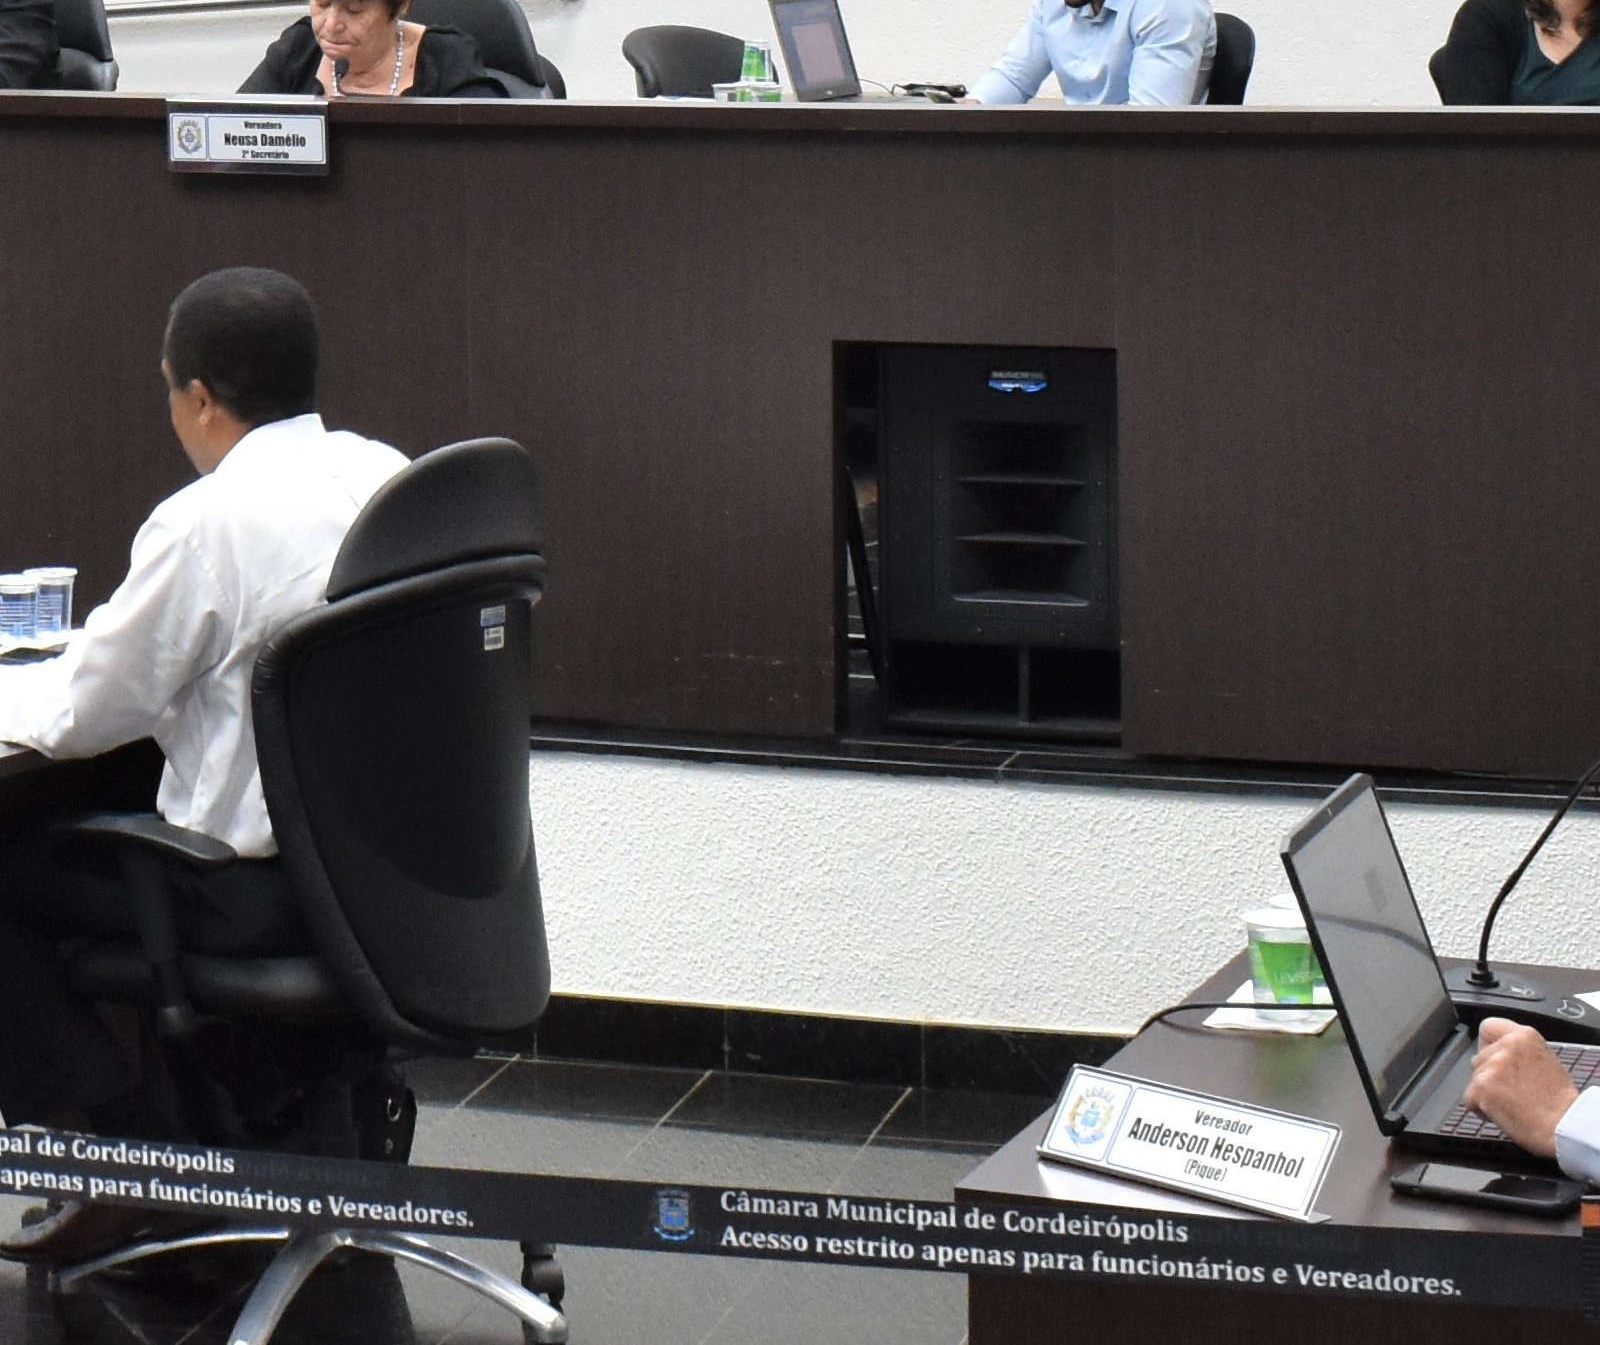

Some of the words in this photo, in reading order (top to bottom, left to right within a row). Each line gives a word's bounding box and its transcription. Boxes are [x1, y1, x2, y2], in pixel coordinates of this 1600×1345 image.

[224, 133, 258, 147] Neusa
[261, 133, 307, 147] Damélio
[244, 121, 282, 129] Vereadora
[1194, 1110, 1253, 1136] Vereador
[37, 1133, 66, 1157] de
[71, 1138, 235, 1175] Cordeirópolis
[1127, 1117, 1210, 1156] Anderson
[1210, 1136, 1305, 1179] Hespanhol
[1184, 1158, 1227, 1183] (Pique)
[0, 1167, 84, 1192] apenas
[90, 1176, 144, 1199] para
[150, 1179, 302, 1215] funcionários
[308, 1196, 322, 1215] e
[327, 1194, 475, 1228] Vereadores.
[720, 1190, 819, 1219] Câmara
[826, 1197, 957, 1232] Municipal
[964, 1207, 996, 1231] de
[1003, 1209, 1189, 1245] Cordeirópolis
[721, 1225, 808, 1252] Acesso
[815, 1234, 915, 1262] restrito
[921, 1243, 1016, 1268] apenas
[1023, 1250, 1085, 1273] para
[1091, 1249, 1266, 1285] funcionários
[1273, 1266, 1288, 1285] e
[1295, 1263, 1462, 1297] Vereadores.
